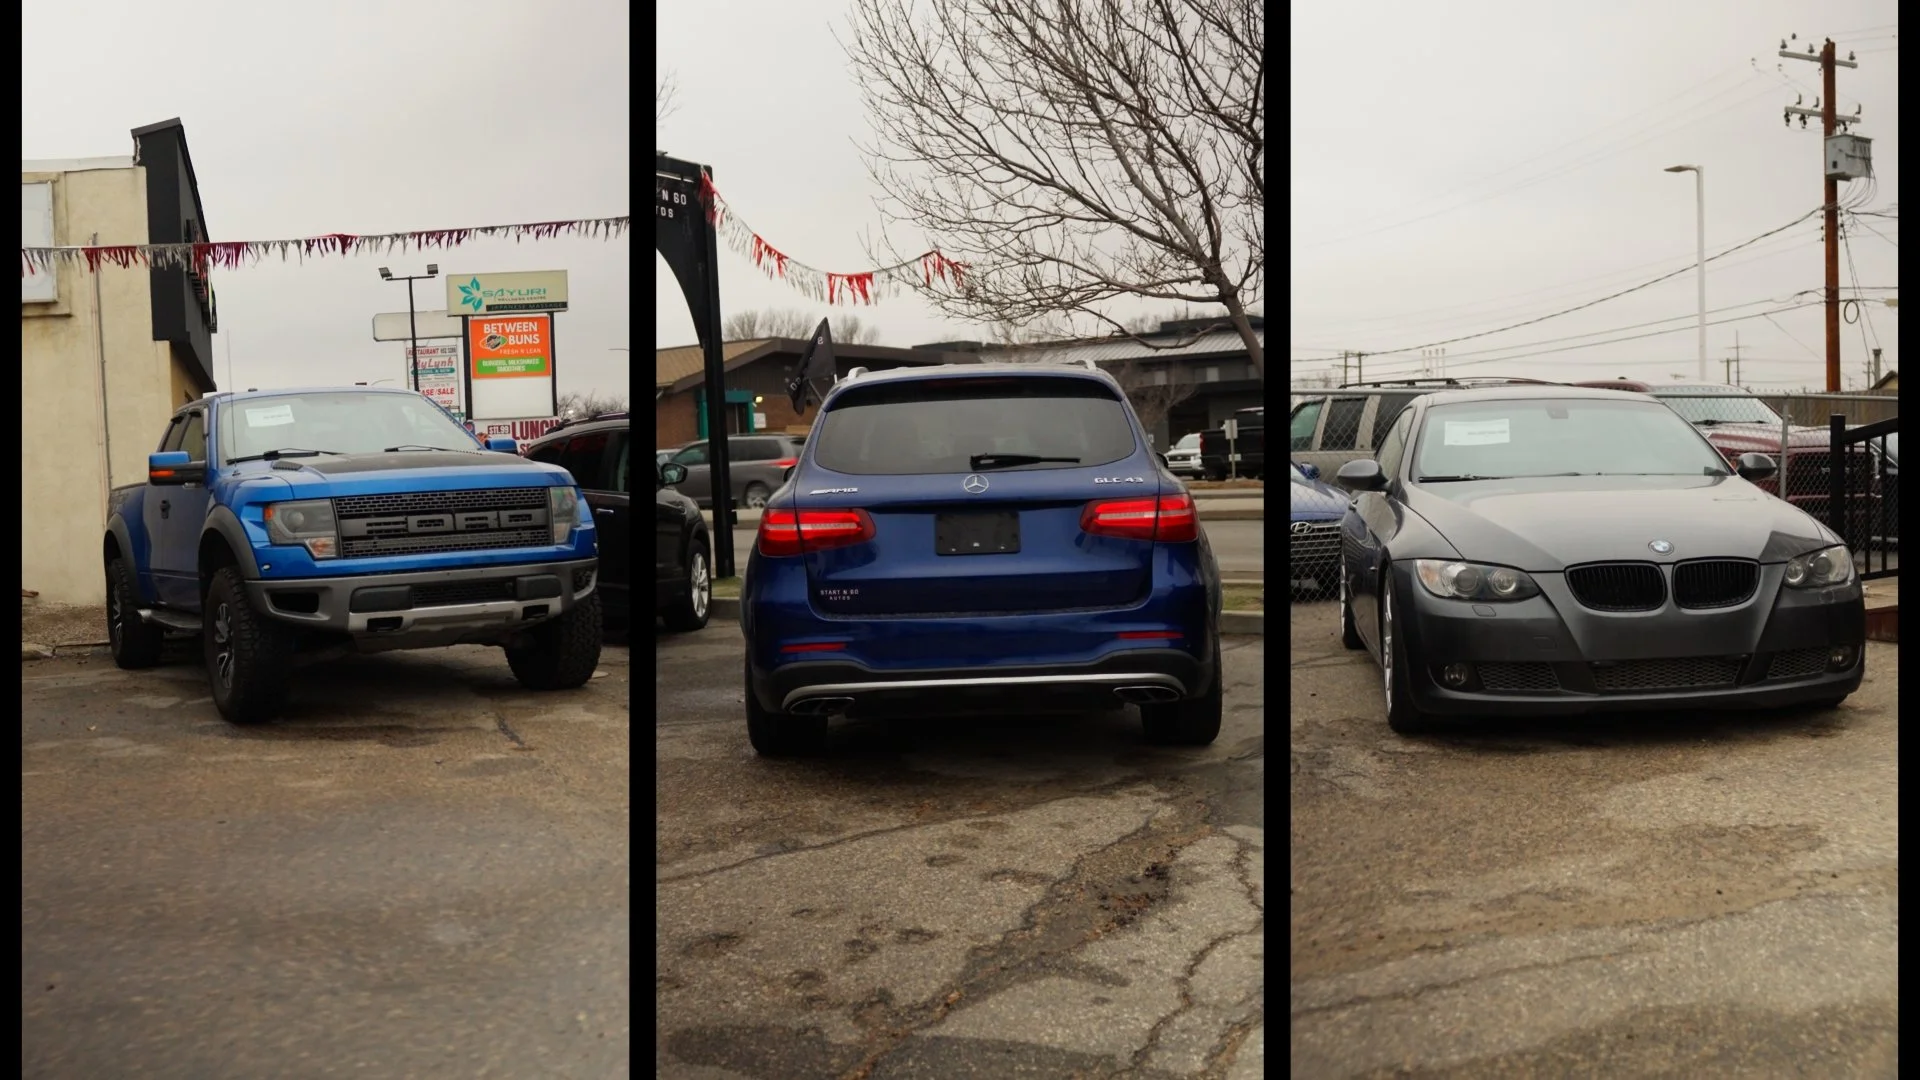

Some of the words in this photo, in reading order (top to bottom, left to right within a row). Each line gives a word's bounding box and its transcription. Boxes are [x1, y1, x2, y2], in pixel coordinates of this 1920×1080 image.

[662, 189, 669, 201] N
[673, 192, 687, 206] GO
[482, 288, 547, 298] SAYURI
[483, 322, 538, 333] BETWEEN
[508, 334, 540, 345] BUNS
[488, 425, 509, 434] $11.99
[340, 509, 546, 536] FORD
